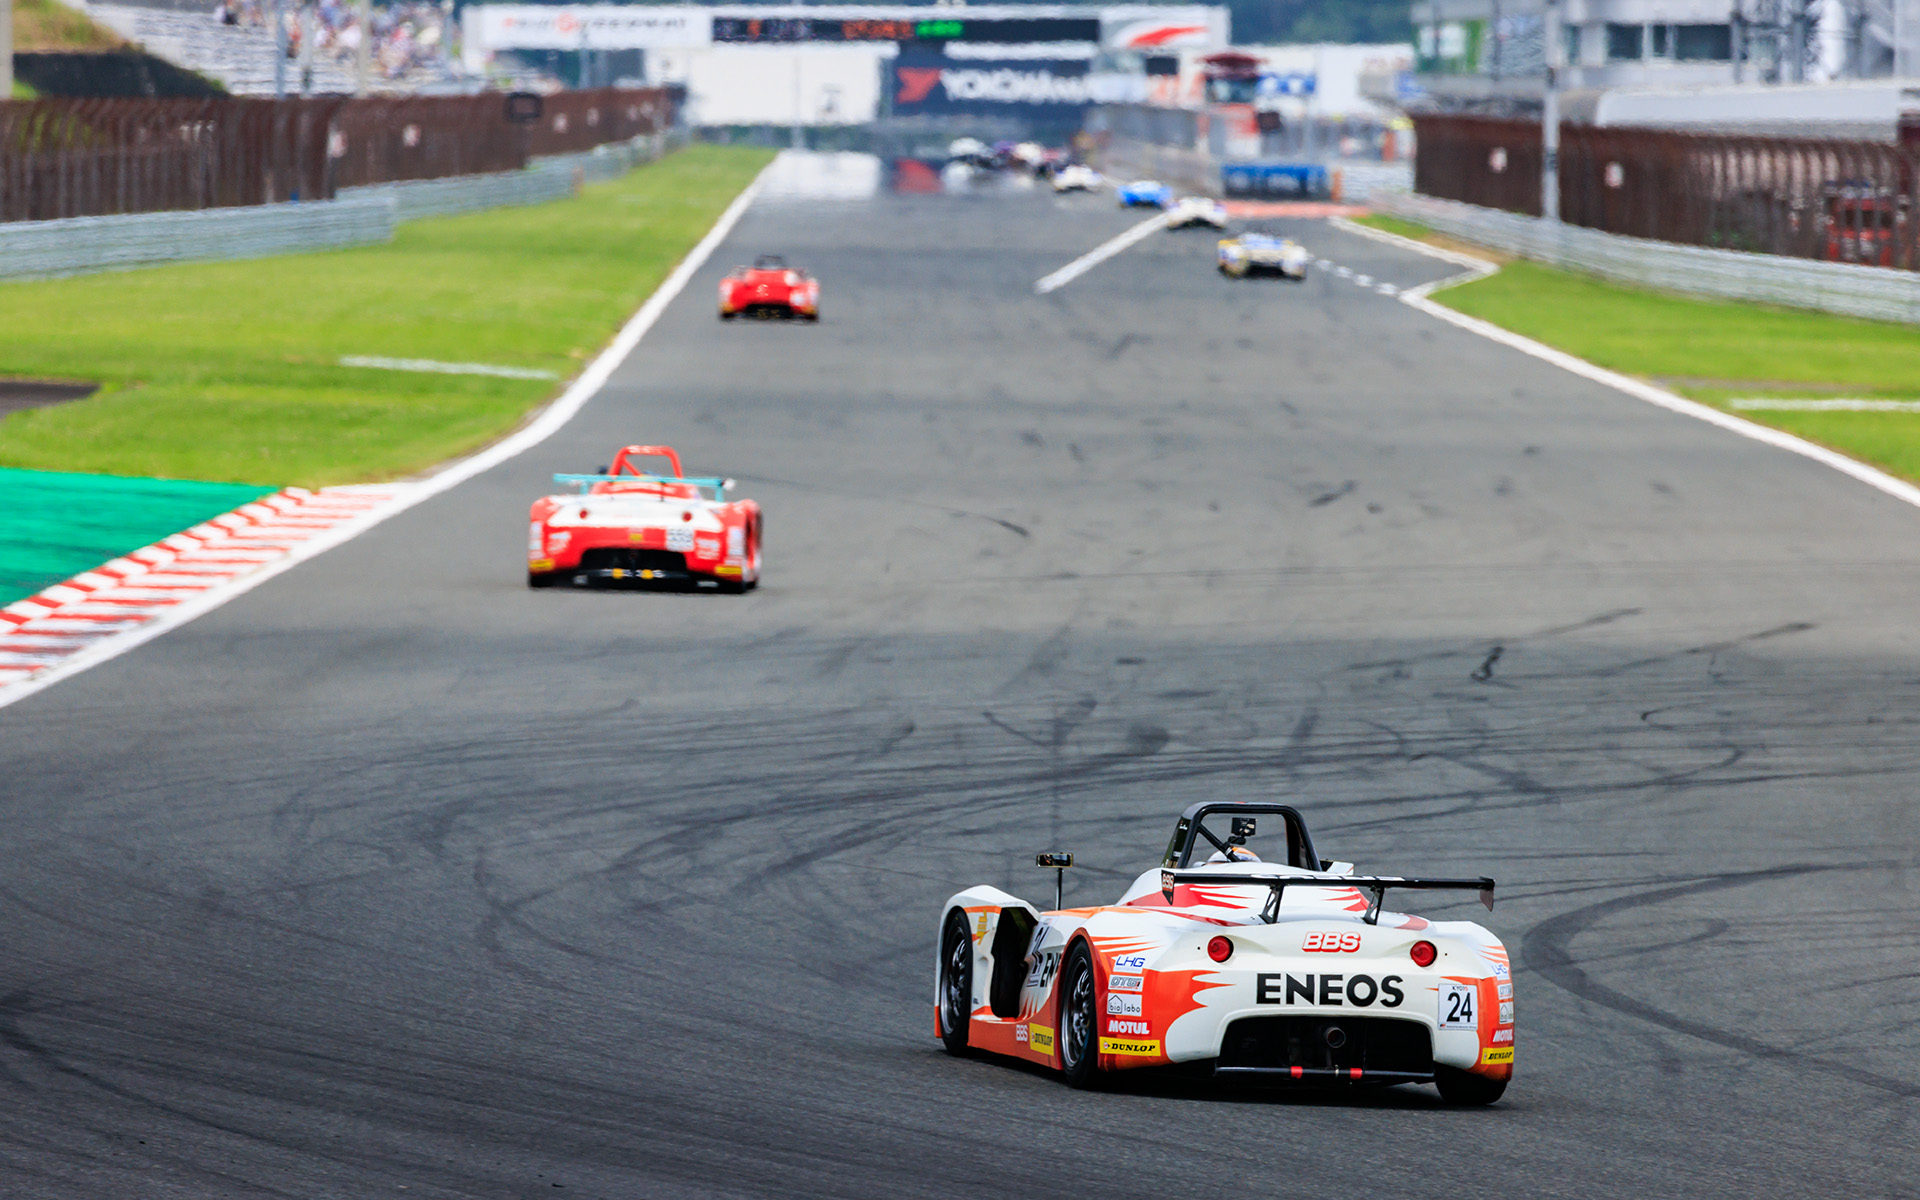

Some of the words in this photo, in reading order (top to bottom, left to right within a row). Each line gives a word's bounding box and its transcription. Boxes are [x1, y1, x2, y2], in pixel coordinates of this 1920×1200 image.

[1301, 931, 1361, 953] BBS
[1116, 956, 1146, 968] LHG
[1256, 972, 1405, 1007] ENEOS
[1124, 1003, 1141, 1013] labo
[1446, 991, 1473, 1023] 24
[1016, 1024, 1028, 1042] BBS
[1108, 1020, 1150, 1035] MOTUL
[1111, 1042, 1156, 1052] DUNLOP
[1488, 1051, 1513, 1060] DUNLOP
